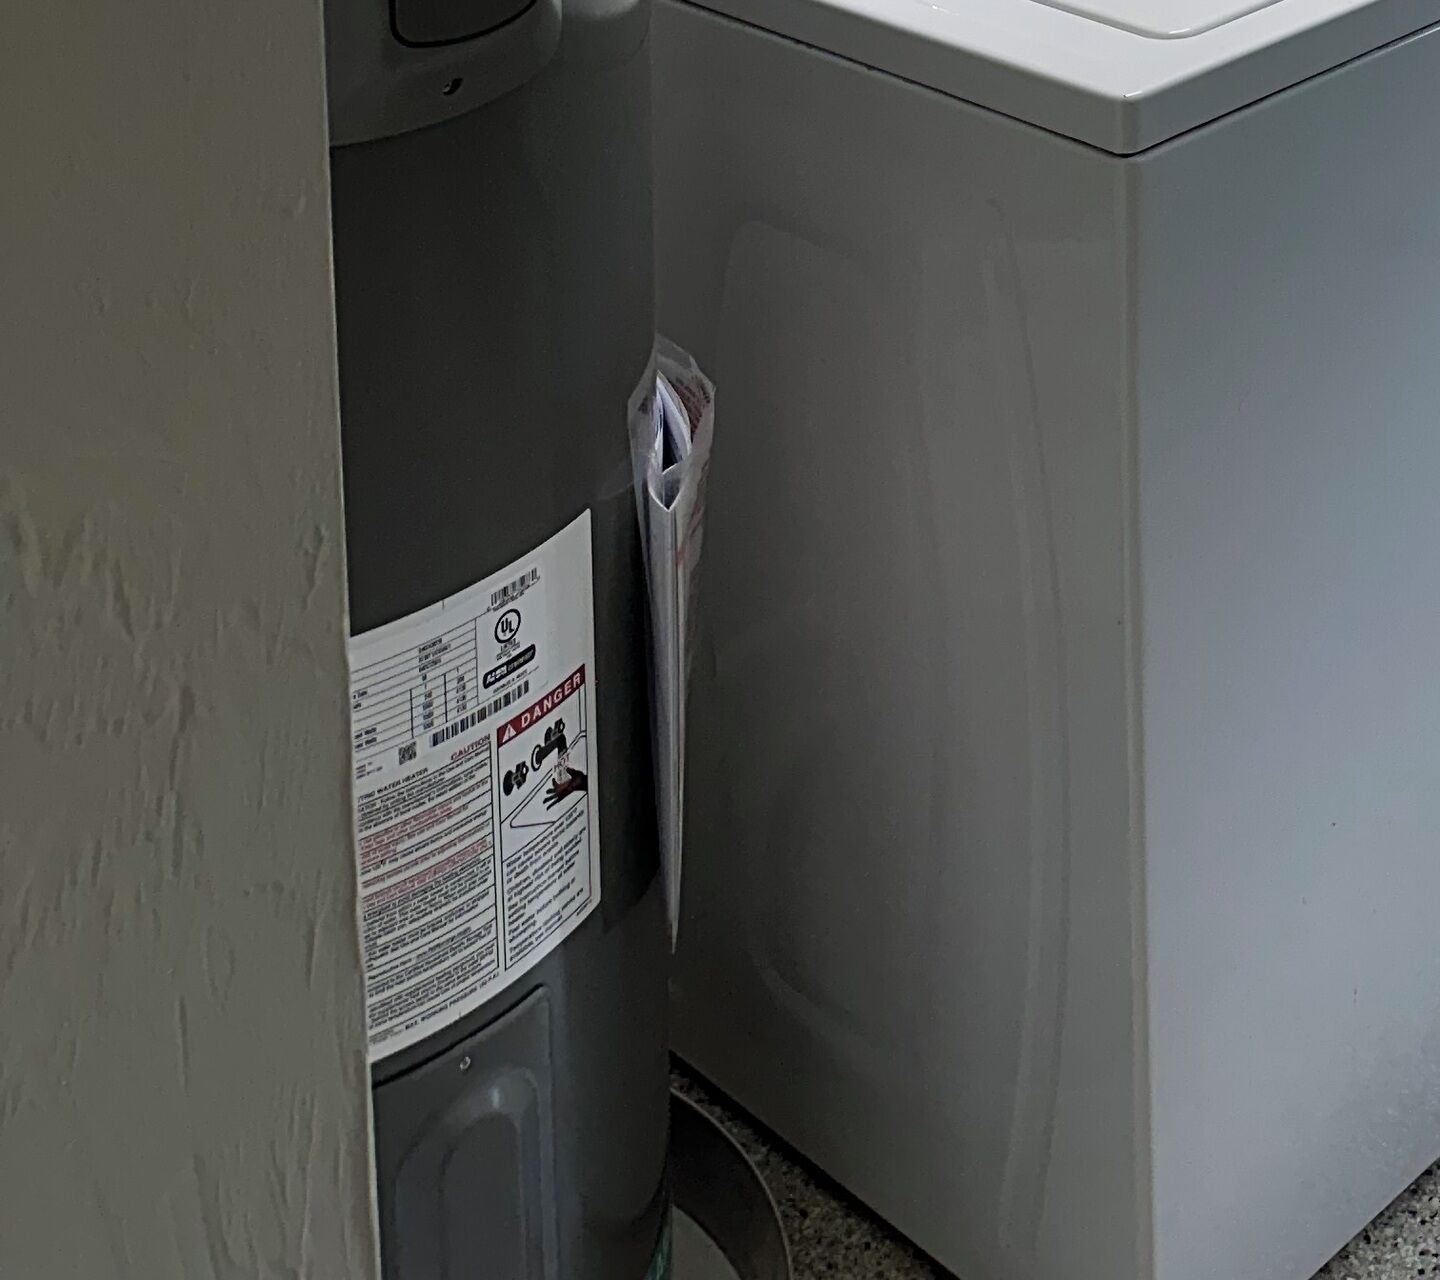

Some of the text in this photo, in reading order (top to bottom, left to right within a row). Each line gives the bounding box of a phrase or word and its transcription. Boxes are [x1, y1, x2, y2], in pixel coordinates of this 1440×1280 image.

[500, 618, 515, 635] UL
[521, 672, 581, 728] DANGER
[450, 734, 491, 760] CAUTION
